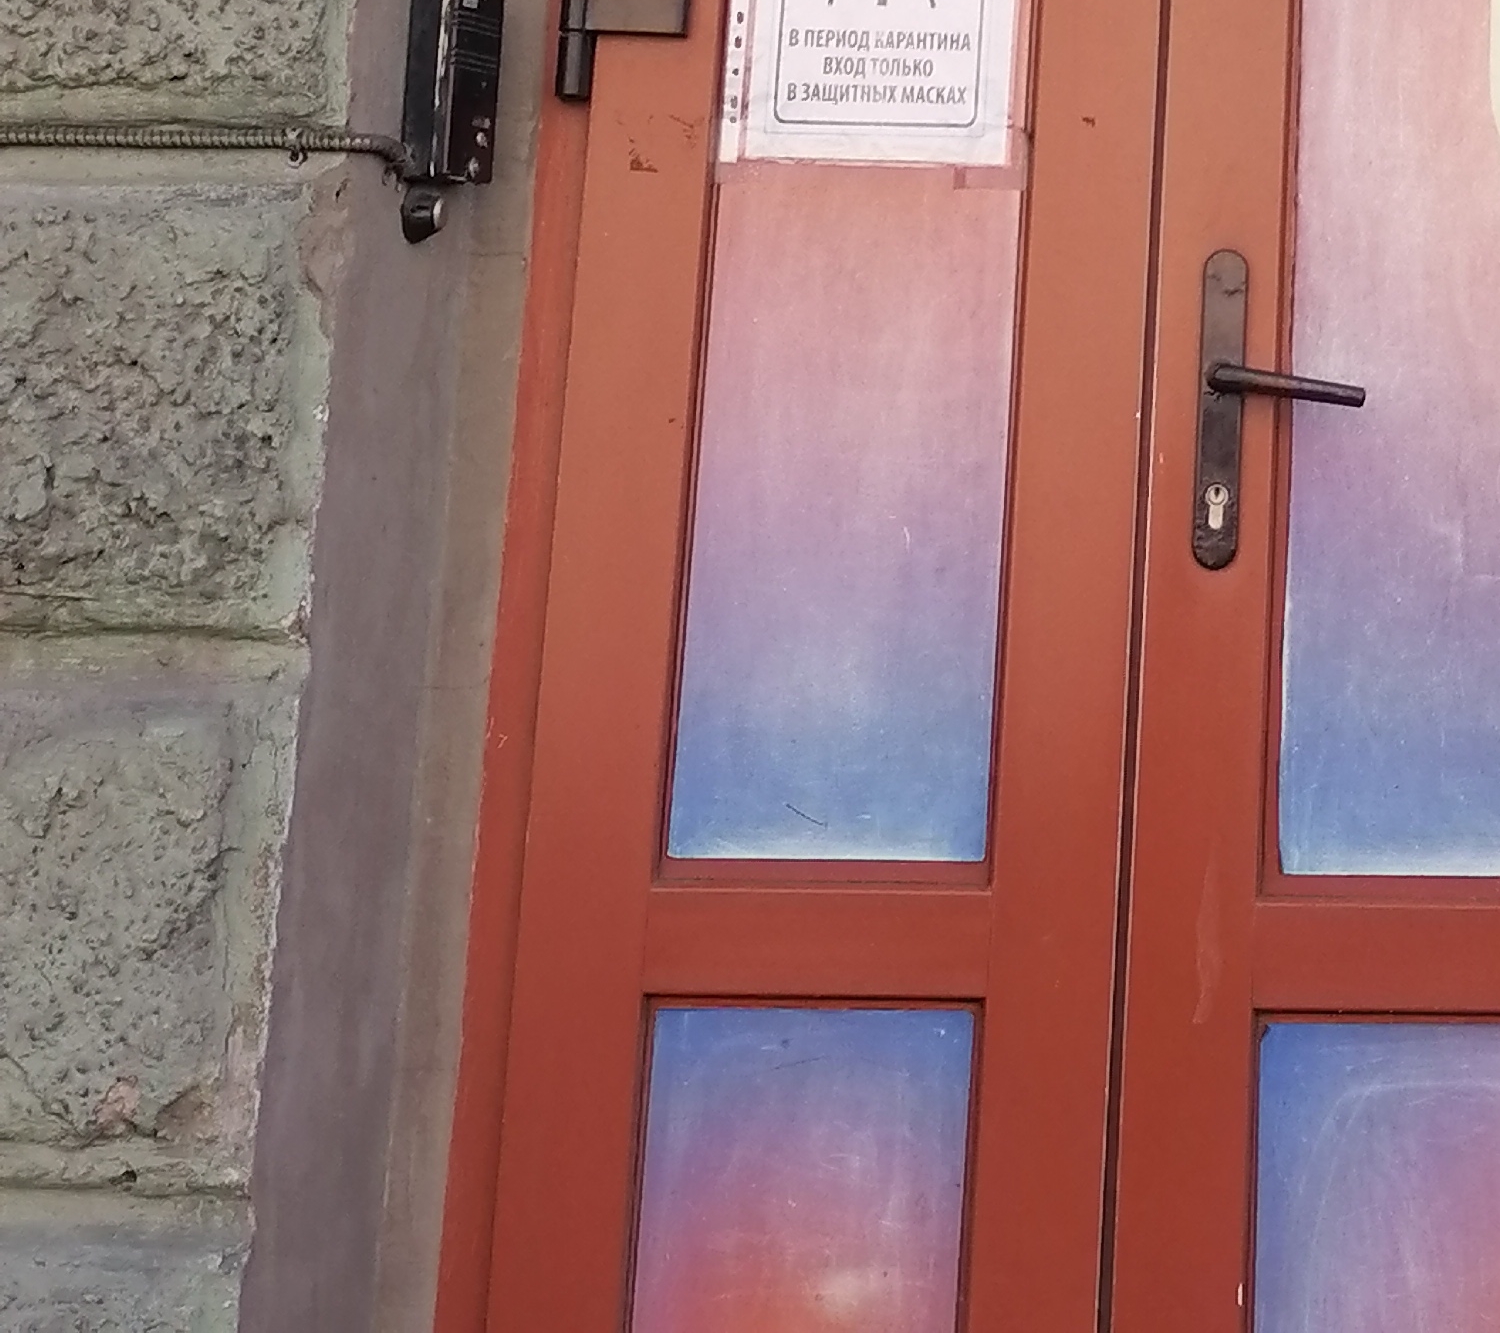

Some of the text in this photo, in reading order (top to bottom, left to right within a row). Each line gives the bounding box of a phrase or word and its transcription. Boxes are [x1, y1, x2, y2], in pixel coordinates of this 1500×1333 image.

[788, 28, 971, 53] В ПЕРИОД КАРАНТИНА
[822, 56, 934, 79] ВХОД ТОЛЬКО
[786, 83, 967, 106] В ЗАЩИТНЫХ МАСКАХ
